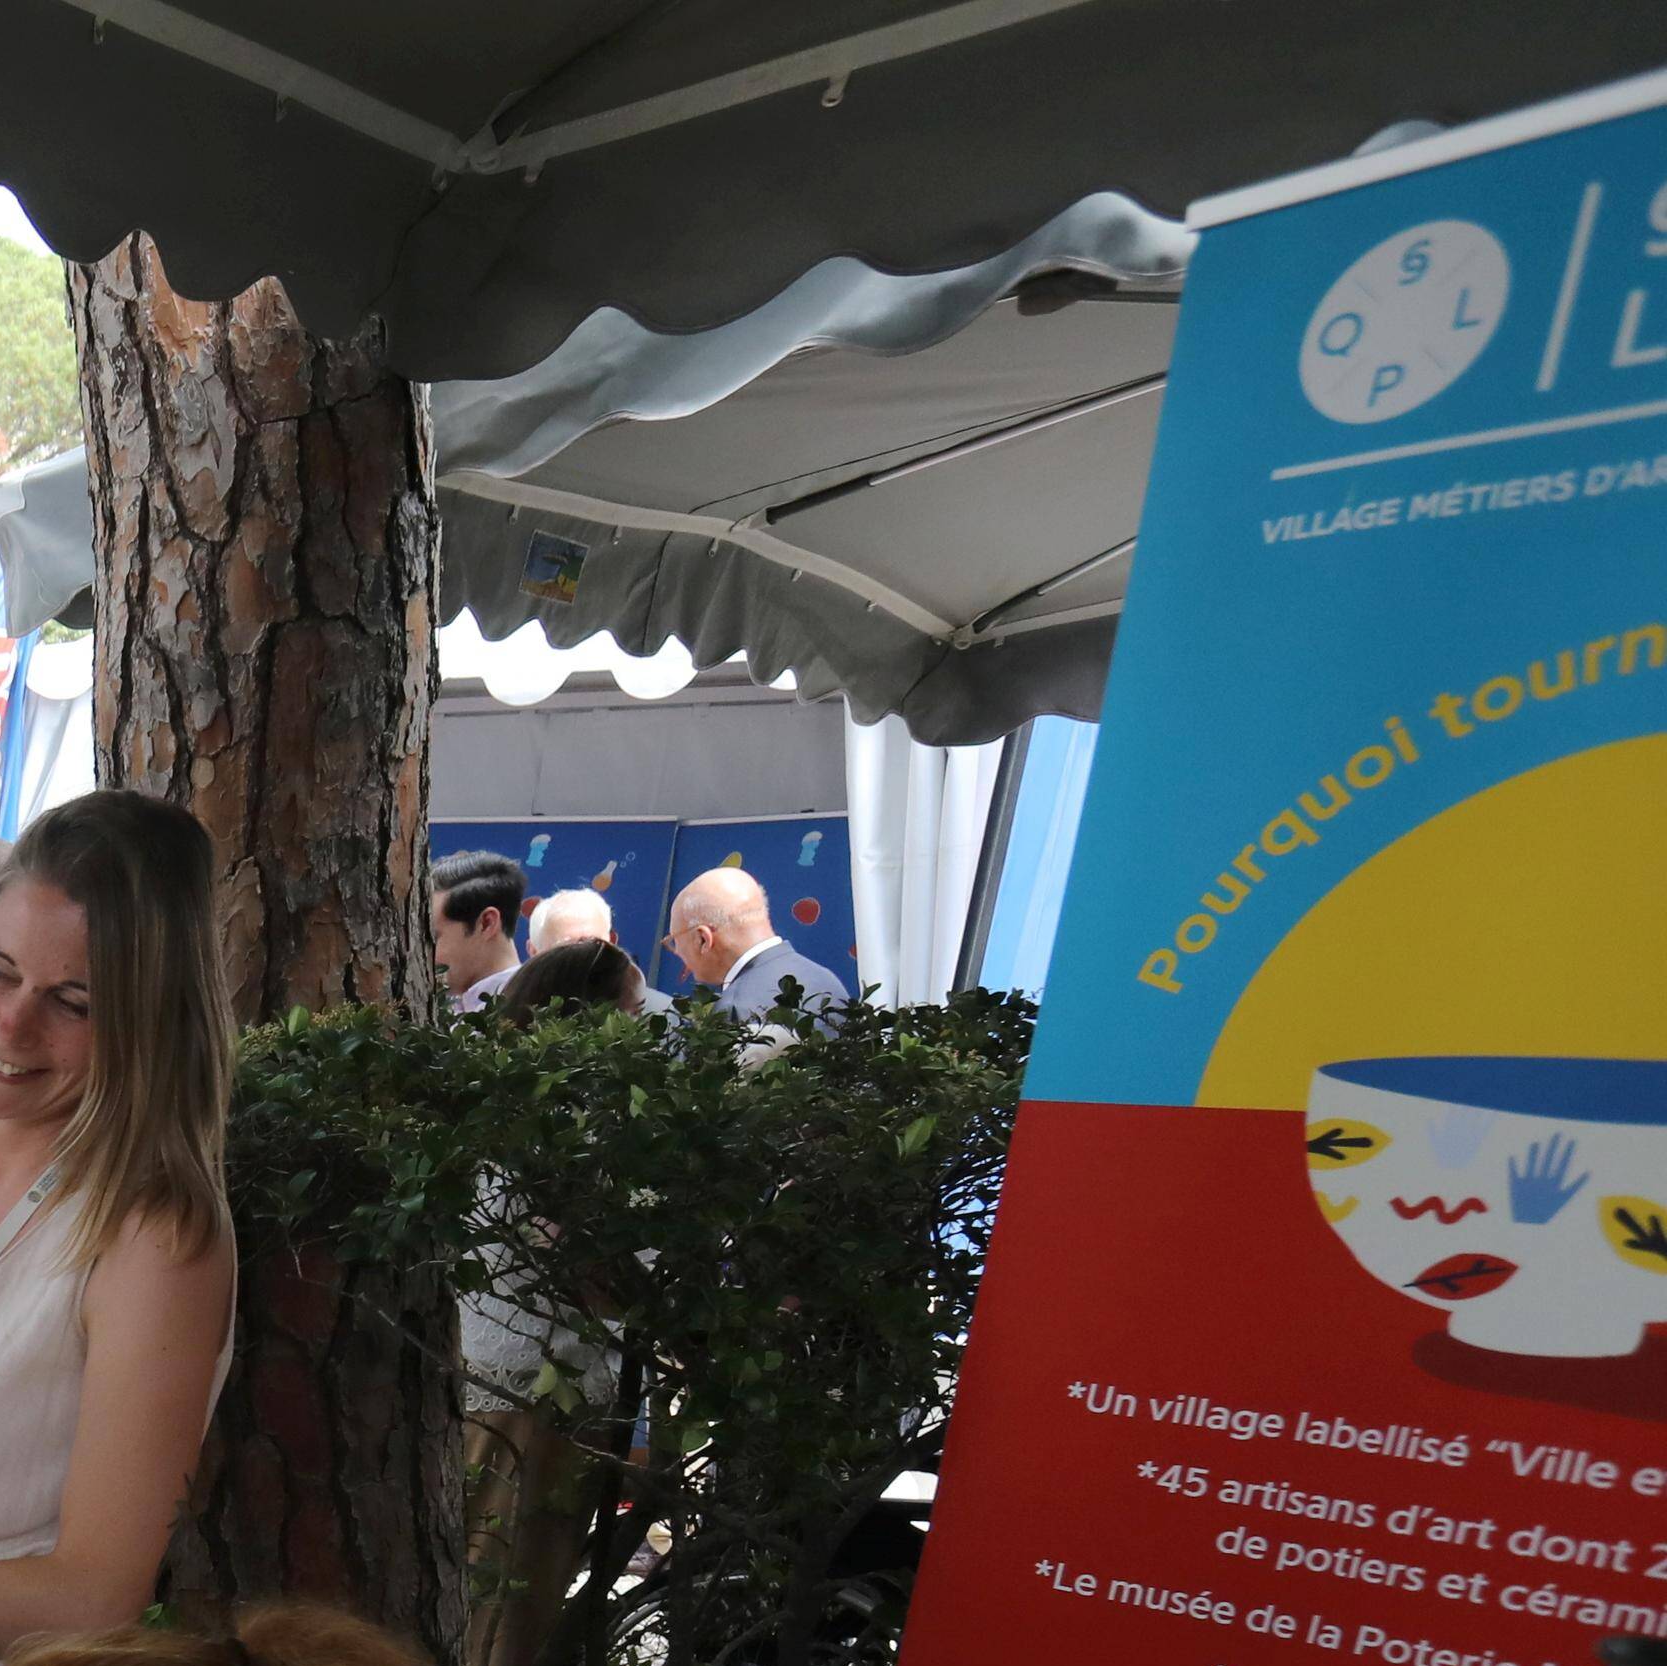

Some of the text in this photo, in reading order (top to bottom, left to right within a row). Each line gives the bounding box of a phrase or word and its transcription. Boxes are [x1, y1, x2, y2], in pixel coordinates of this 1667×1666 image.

[1261, 497, 1399, 545] VILLAGE
[1407, 468, 1577, 522] MÉTIERS
[1136, 622, 1667, 995] Pourquoi tourn
[1149, 1394, 1284, 1441] village
[1295, 1412, 1469, 1468] labellisé
[1215, 1526, 1268, 1560] de
[1276, 1540, 1426, 1593] potiers
[1437, 1570, 1490, 1605] et
[1218, 1478, 1375, 1528] artisans
[1507, 1524, 1636, 1575] dont
[1108, 1578, 1235, 1625] musée
[1246, 1603, 1298, 1641] de
[1306, 1613, 1341, 1651] la
